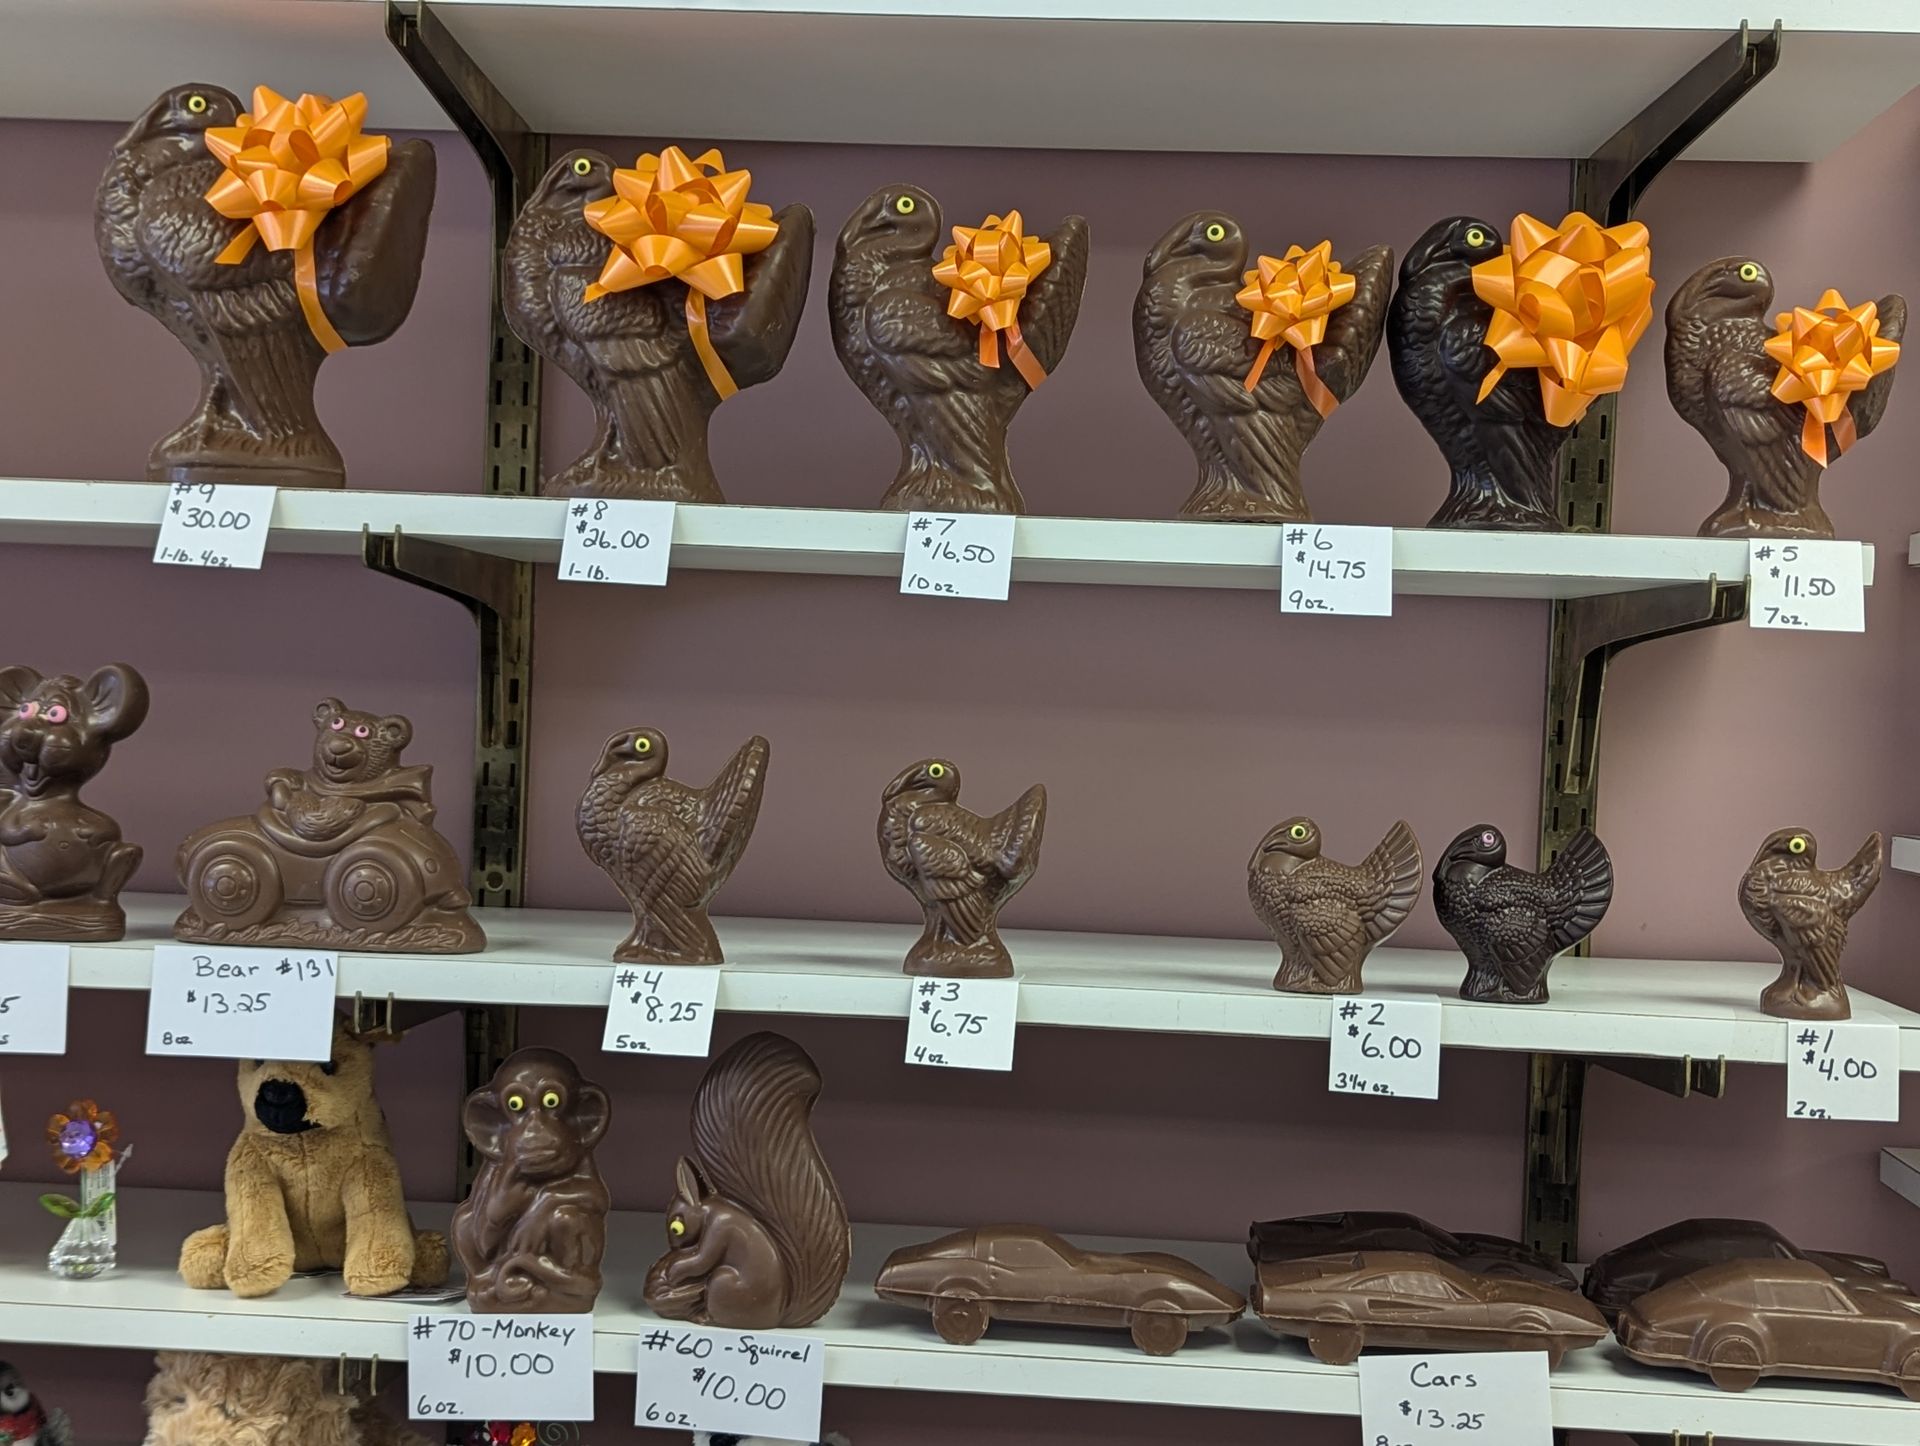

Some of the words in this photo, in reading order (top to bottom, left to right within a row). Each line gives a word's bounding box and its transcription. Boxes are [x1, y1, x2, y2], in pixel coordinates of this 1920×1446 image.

[170, 499, 250, 530] $30.00
[571, 500, 608, 520] #8
[576, 520, 649, 549] $26.00
[912, 517, 957, 536] #7
[1286, 528, 1333, 550] #6
[1296, 551, 1366, 579] $14.75
[1755, 545, 1799, 562] #5
[1770, 566, 1835, 597] $11.50
[192, 955, 260, 979] Bear
[275, 957, 334, 981] #131
[616, 969, 663, 994] #4
[186, 989, 271, 1014] $13.25
[918, 981, 960, 1001] #3
[630, 991, 703, 1023] $8.25
[919, 1000, 988, 1037] $6.75
[1339, 1001, 1385, 1026] #2
[1347, 1024, 1422, 1059] $6.00
[1797, 1028, 1834, 1054] #1
[1802, 1049, 1877, 1081] $4.00
[448, 1348, 554, 1378] $10.00
[1410, 1361, 1478, 1388] Cars
[692, 1367, 786, 1410] $10.00
[1399, 1400, 1486, 1430] $13.25
